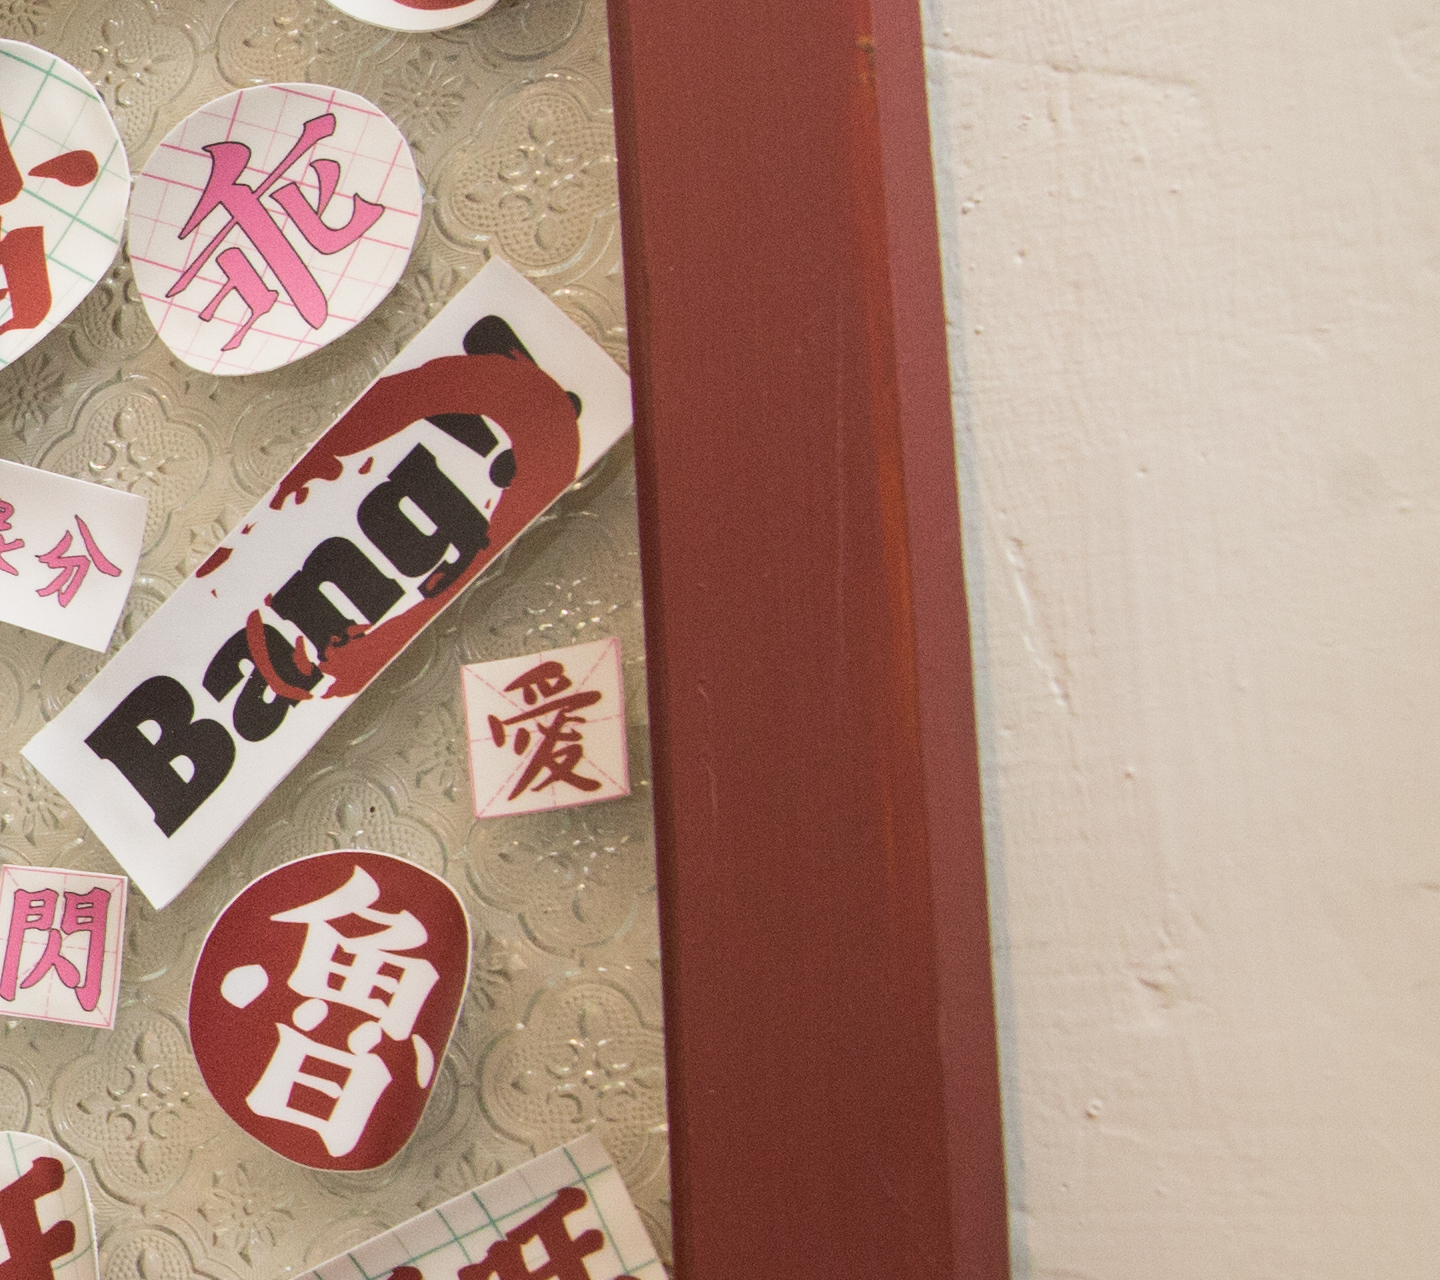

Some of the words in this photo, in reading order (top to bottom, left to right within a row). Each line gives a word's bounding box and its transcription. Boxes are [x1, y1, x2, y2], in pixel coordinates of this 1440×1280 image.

[166, 113, 385, 351] 乖
[488, 661, 603, 802] 愛
[221, 865, 440, 1158] 魯
